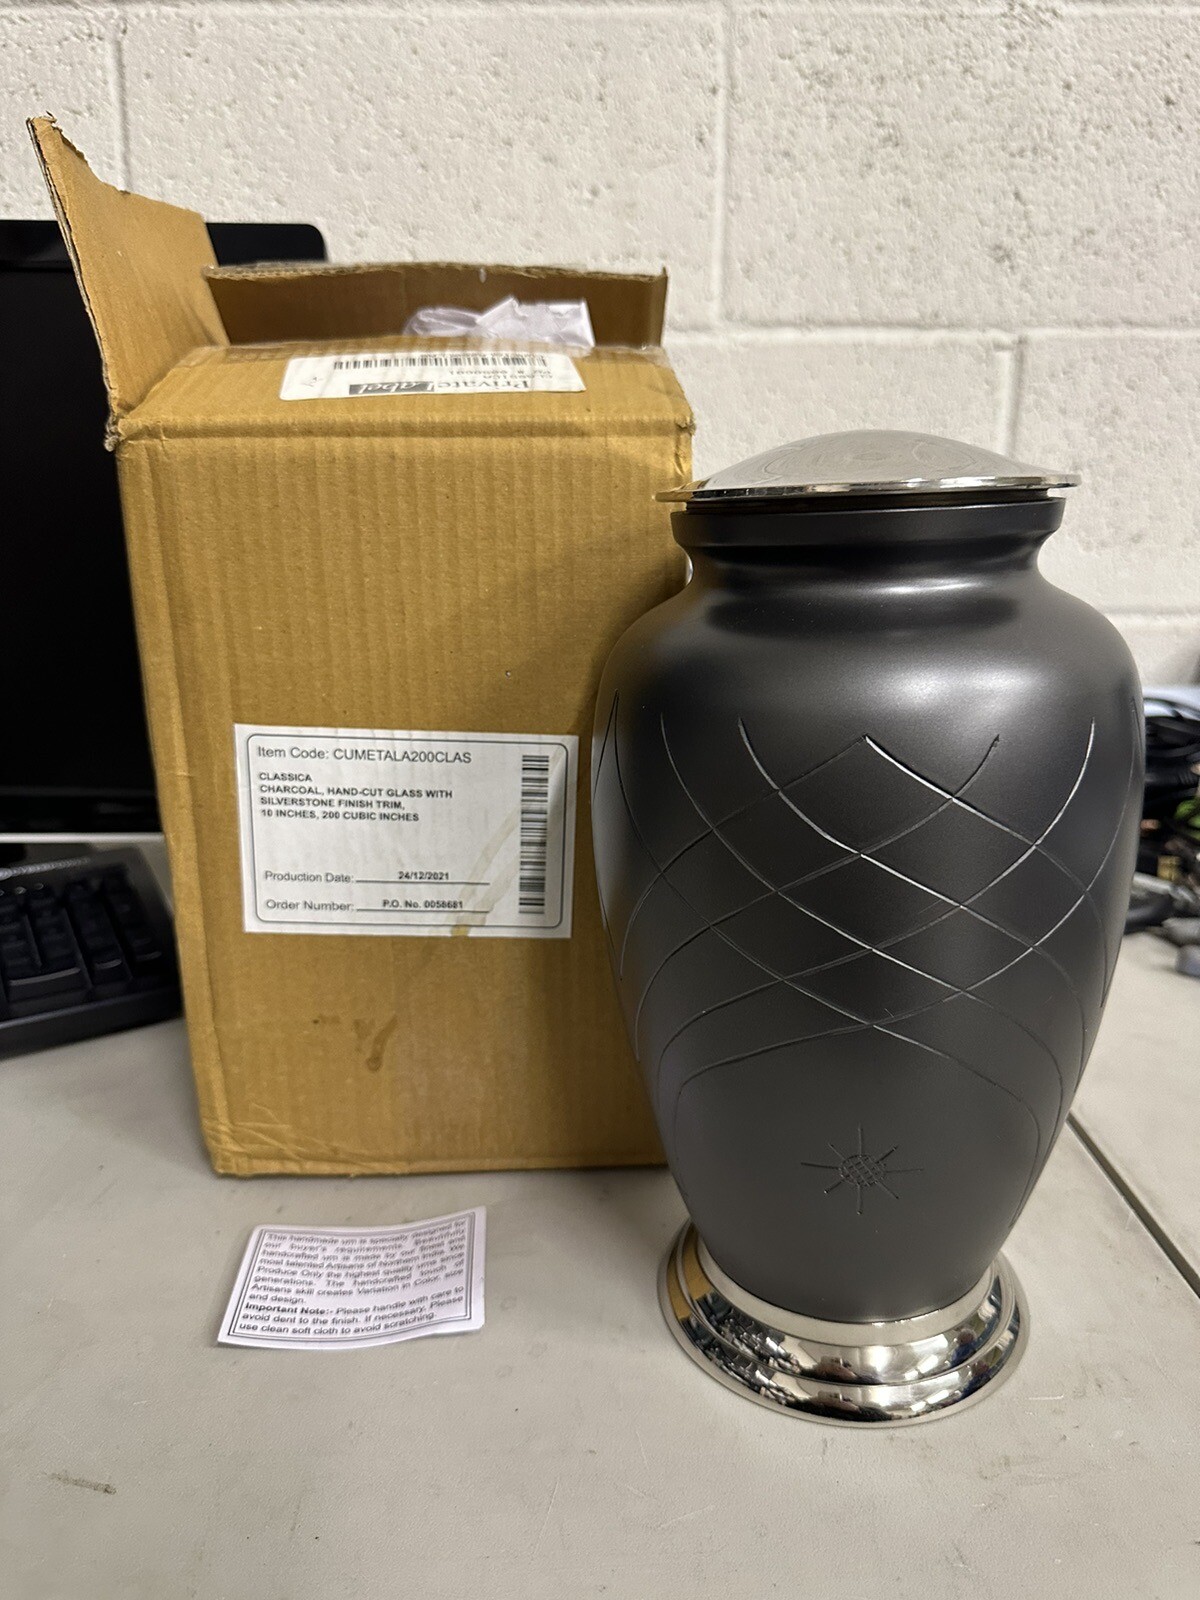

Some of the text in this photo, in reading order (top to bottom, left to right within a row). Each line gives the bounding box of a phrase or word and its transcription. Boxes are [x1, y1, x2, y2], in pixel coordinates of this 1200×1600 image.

[359, 380, 530, 394] Private Label
[258, 746, 472, 763] Item Code: CUMETALA200CLAS
[259, 773, 312, 781] CLASSICA
[260, 785, 453, 798] CHARCOAL, HAND-CUT GLASS WITH
[261, 797, 405, 810] SILVERSTONE FINISH TRIM,
[276, 810, 319, 820] INCHES,
[343, 812, 376, 820] CUBIC
[379, 813, 419, 821] INCHES
[265, 871, 449, 882] Production Date: 24/12/2021
[266, 900, 299, 909] Order
[304, 901, 354, 911] Number:
[382, 899, 402, 908] P.O.
[405, 900, 421, 909] No.
[290, 1235, 338, 1244] handmade
[411, 1223, 452, 1239] designed
[261, 1250, 319, 1259] handcrafted
[449, 1236, 465, 1244] and
[257, 1266, 297, 1275] Produce
[301, 1269, 324, 1278] Only
[343, 1269, 380, 1279] highest
[353, 1273, 412, 1286] handcrafted
[421, 1265, 446, 1276] touch
[252, 1283, 292, 1293] Artisans
[357, 1285, 399, 1294] Variation
[444, 1269, 463, 1279] size
[246, 1303, 297, 1313] Important
[336, 1306, 370, 1315] Please
[373, 1301, 406, 1312] handle
[409, 1296, 428, 1305] with
[431, 1289, 452, 1299] care
[271, 1295, 306, 1305] design.
[243, 1313, 271, 1321] avoid
[430, 1296, 463, 1308] Please
[239, 1322, 258, 1331] use
[261, 1324, 289, 1332] clean
[292, 1326, 311, 1334] soft
[314, 1326, 338, 1334] cloth
[353, 1324, 381, 1333] avoid
[384, 1312, 436, 1330] scratching.
